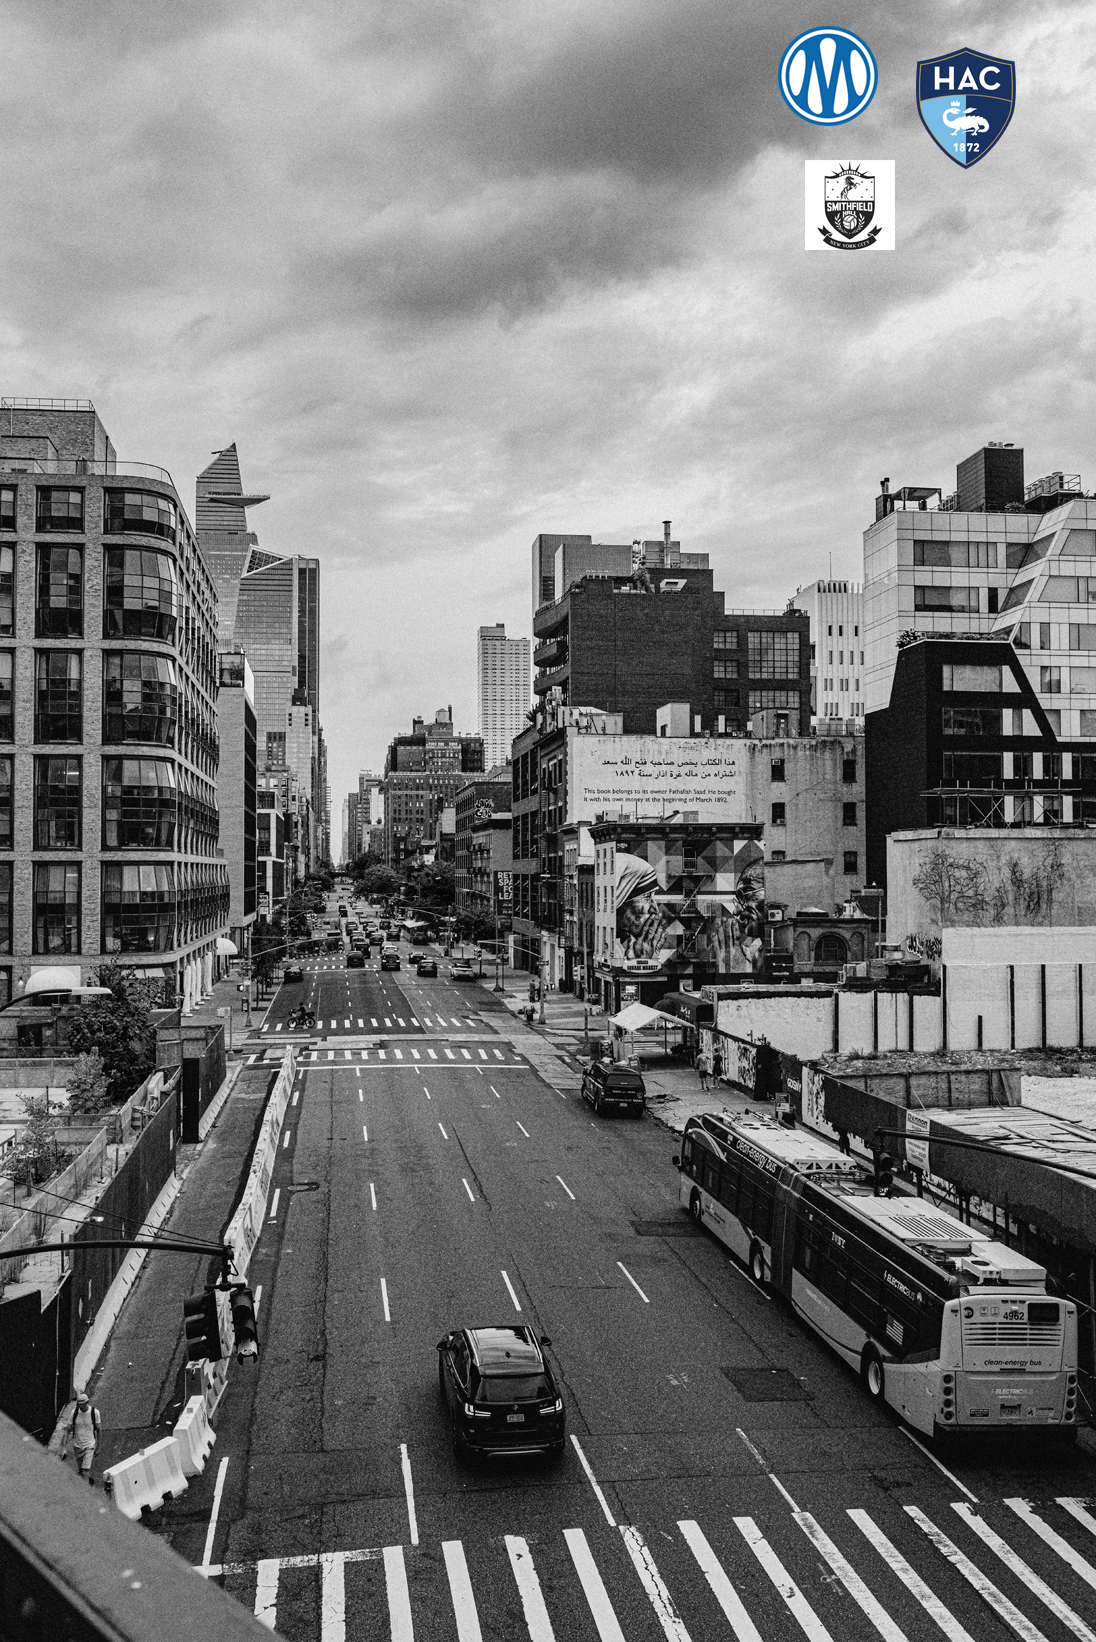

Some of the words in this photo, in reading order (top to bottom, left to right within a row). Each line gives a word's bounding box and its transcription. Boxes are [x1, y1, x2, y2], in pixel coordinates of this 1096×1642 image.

[700, 758, 722, 768] الكتاب
[724, 758, 736, 766] هذا
[700, 771, 711, 779] من
[662, 796, 687, 804] beginning
[736, 1140, 767, 1169] clean-energy
[766, 1157, 778, 1173] bus
[1002, 1311, 1025, 1321] 4962
[983, 1359, 1029, 1367] clean-energy
